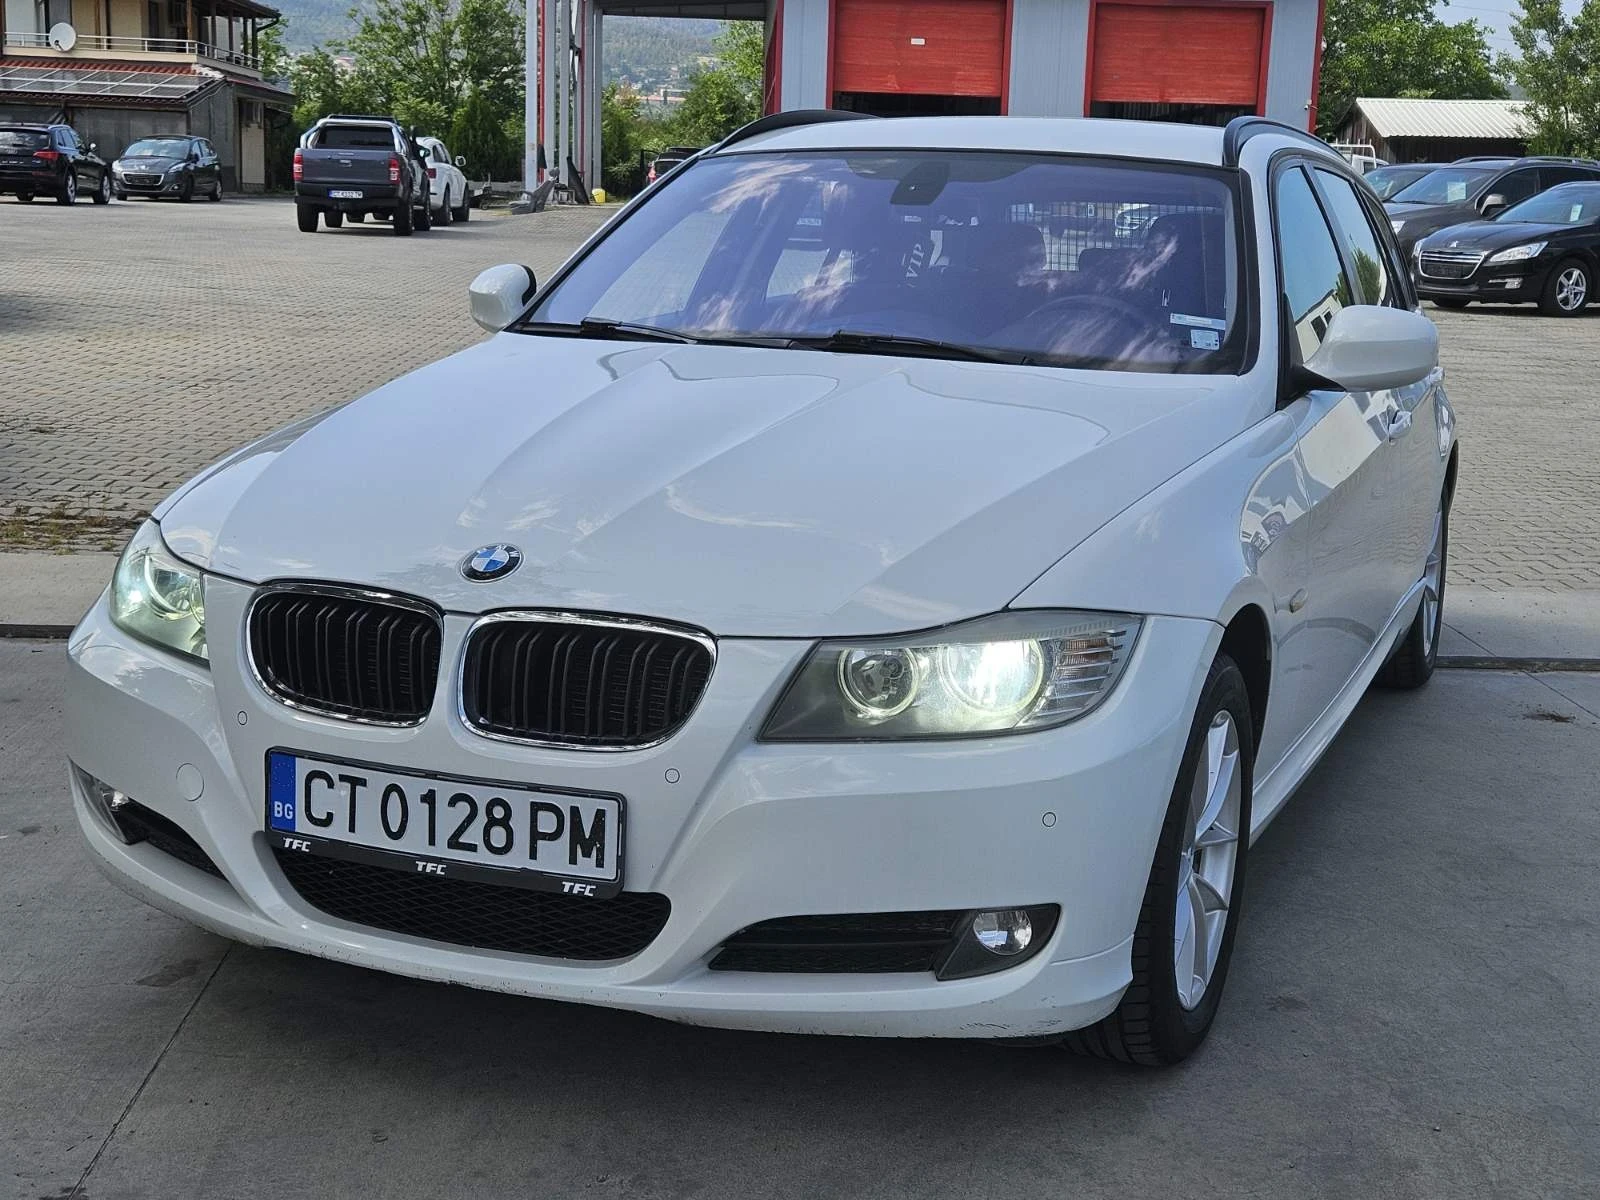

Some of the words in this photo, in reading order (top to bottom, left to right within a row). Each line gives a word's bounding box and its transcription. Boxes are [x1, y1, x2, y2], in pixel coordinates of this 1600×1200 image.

[273, 801, 293, 820] BG
[304, 770, 367, 833] CT
[380, 782, 514, 855] 0128
[528, 801, 606, 868] PM
[283, 837, 310, 853] TFC
[415, 860, 447, 875] TFC
[562, 881, 597, 897] TFC
